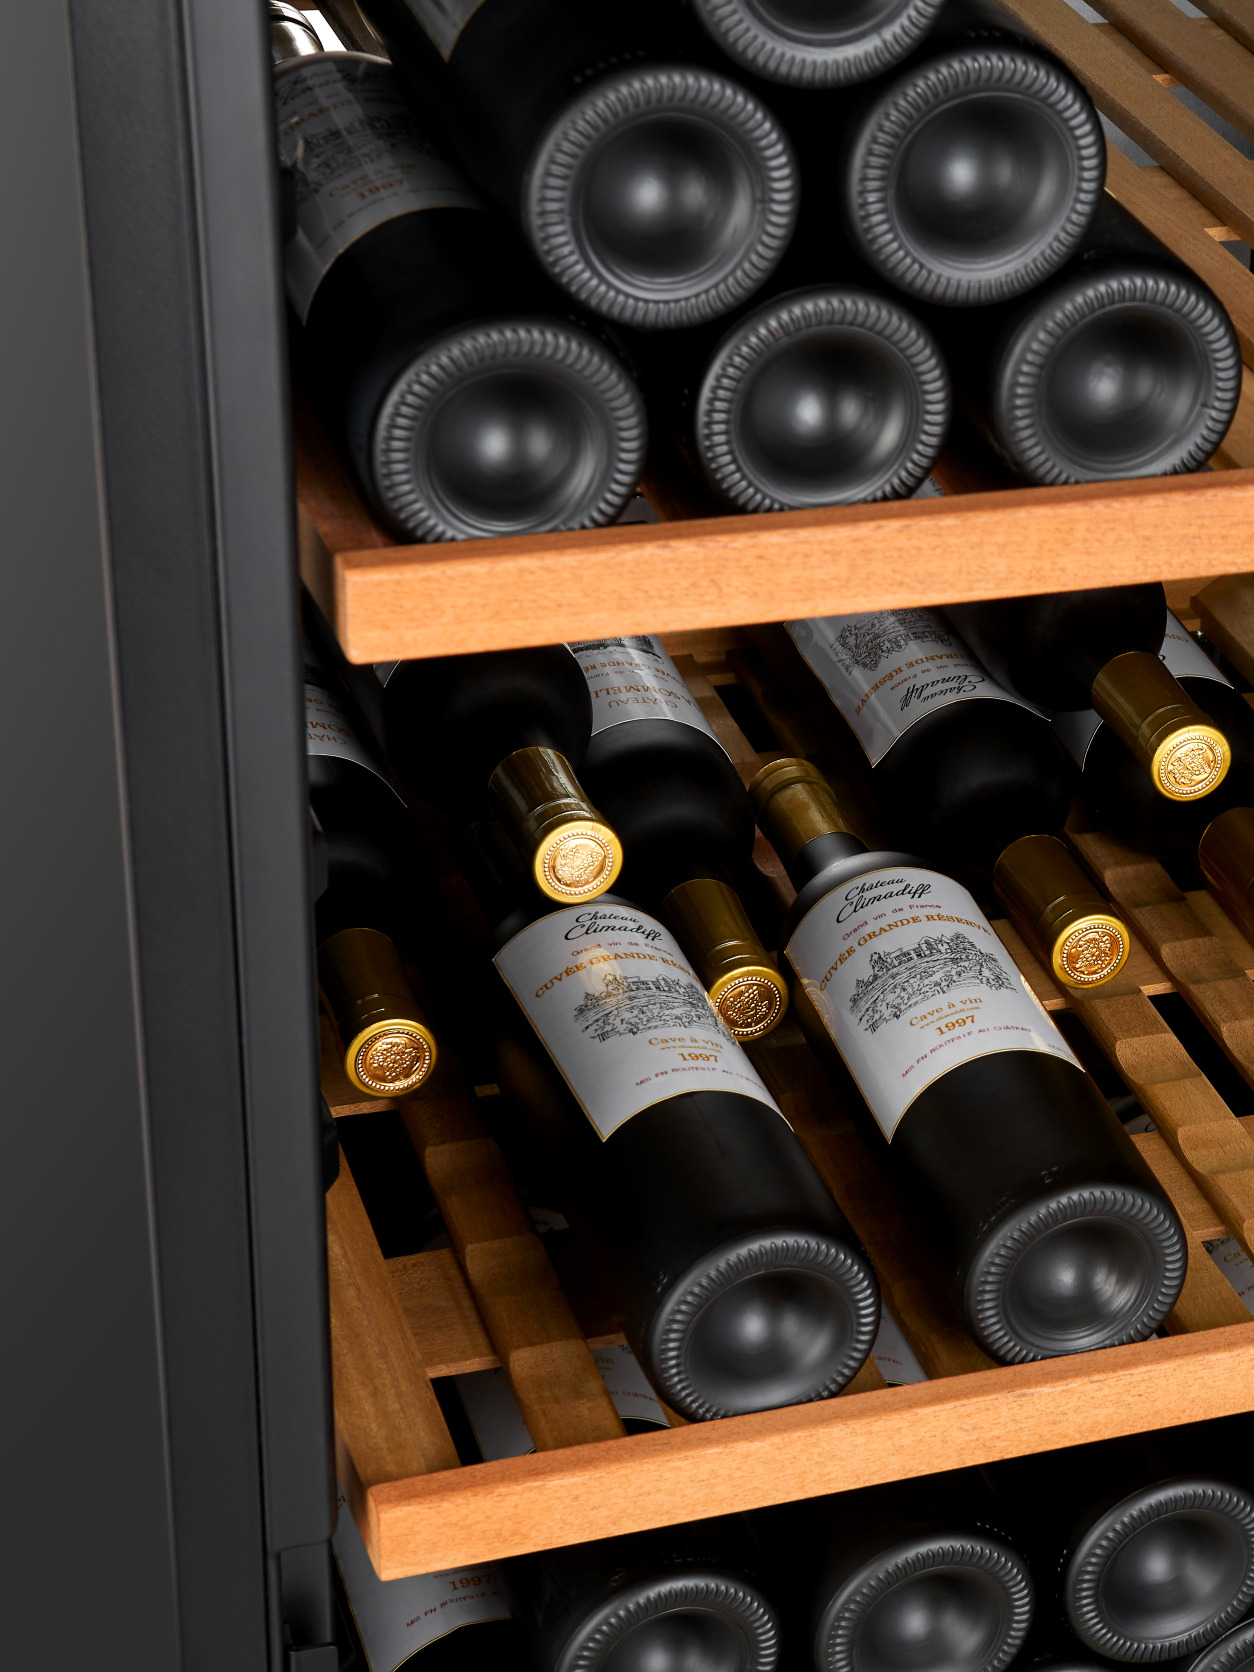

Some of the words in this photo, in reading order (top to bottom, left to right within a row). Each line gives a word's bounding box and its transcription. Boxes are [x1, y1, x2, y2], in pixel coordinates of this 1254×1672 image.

[586, 672, 610, 681] Franc
[592, 684, 682, 701] SOMMELI
[899, 673, 986, 711] Climadiff
[836, 883, 932, 923] Climadiff
[563, 921, 664, 942] Climadiff
[842, 920, 868, 941] Grand
[872, 912, 887, 921] vin
[571, 943, 602, 957] Grand
[819, 946, 856, 992] CUVÉE
[857, 915, 922, 947] GRANDE
[534, 962, 587, 999] CUVÉE
[588, 952, 659, 967] GRANDE
[909, 1007, 944, 1027] Cave
[947, 1001, 957, 1009] à
[960, 996, 983, 1006] vin
[935, 1014, 976, 1037] 1997
[648, 1036, 686, 1046] Cave
[690, 1035, 699, 1044] à
[702, 1039, 723, 1049] vin
[678, 1052, 718, 1063] 1997
[449, 1574, 492, 1591] 1997
